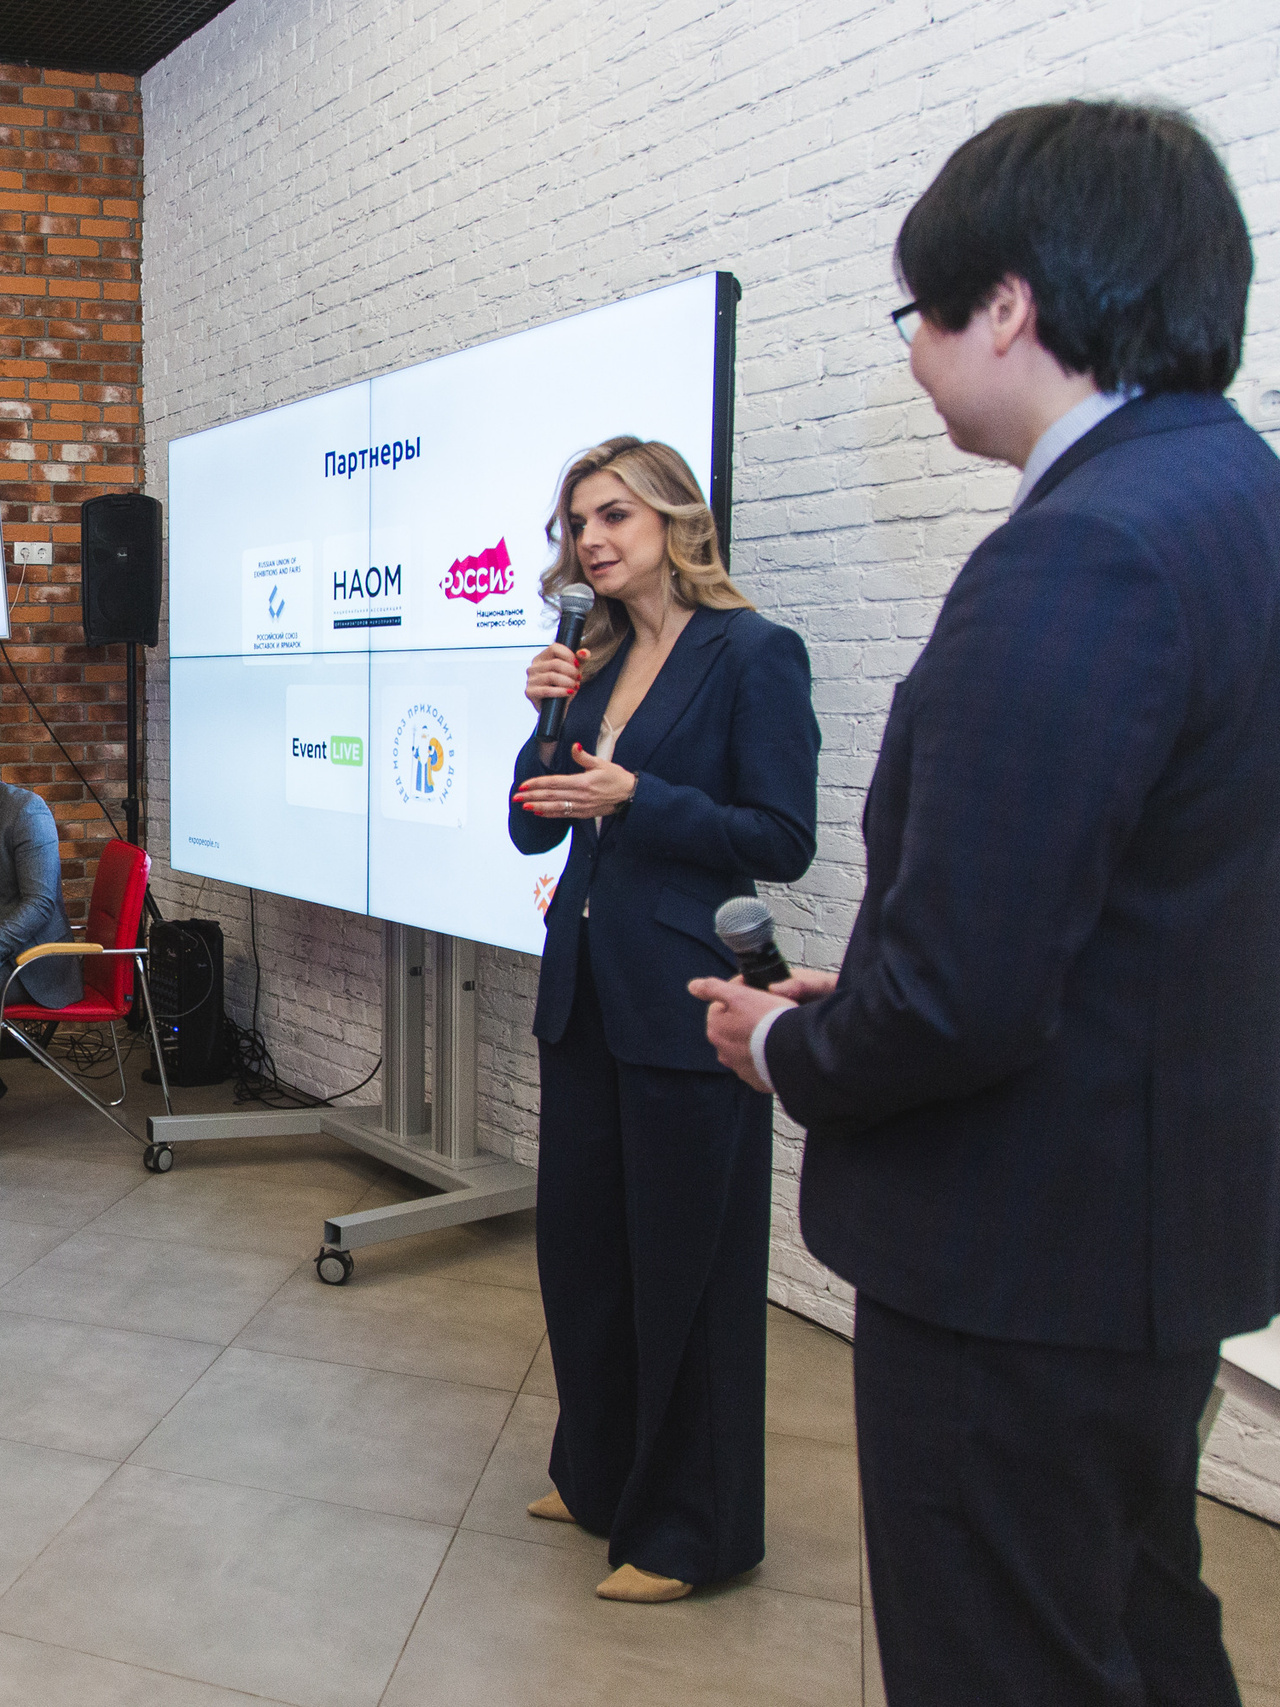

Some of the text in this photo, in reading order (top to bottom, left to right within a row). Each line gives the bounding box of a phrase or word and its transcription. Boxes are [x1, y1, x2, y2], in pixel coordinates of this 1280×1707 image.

[324, 436, 421, 480] Партнеры
[258, 556, 297, 568] RUSSIAN UNION OF
[253, 569, 278, 578] EXHIBITIONS
[289, 565, 301, 573] FAIRS
[333, 564, 402, 601] НАОМ
[444, 566, 515, 596] РОССИЯ
[476, 608, 524, 618] Национальное
[476, 618, 526, 629] конгресс-бюро
[256, 632, 298, 641] РОССИЙСКИЙ СОЮЗ
[253, 642, 276, 650] ВЫСТАВОК
[281, 641, 301, 649] ЯРМАРОК
[407, 703, 453, 742] ПРИХОДИТ
[292, 737, 361, 761] Event LIVE
[392, 718, 407, 770] МОРОЗ
[448, 749, 455, 758] В
[395, 776, 410, 804] ДЕД
[188, 836, 220, 849] expopeople.ru
